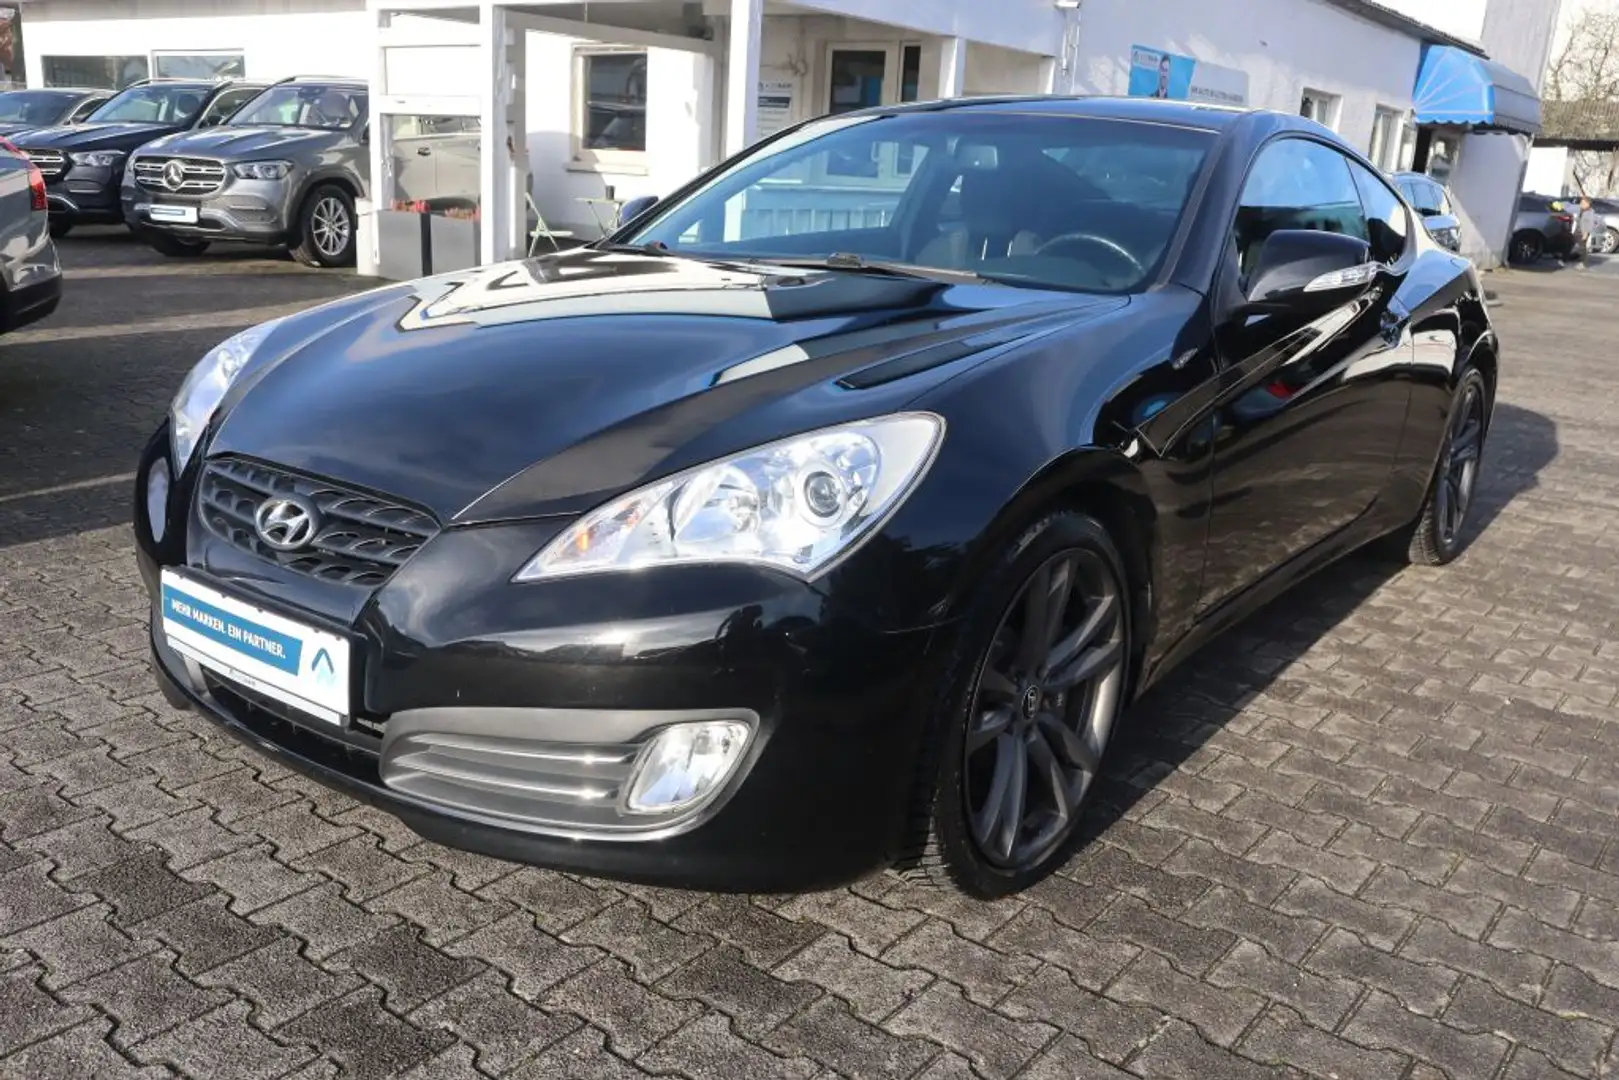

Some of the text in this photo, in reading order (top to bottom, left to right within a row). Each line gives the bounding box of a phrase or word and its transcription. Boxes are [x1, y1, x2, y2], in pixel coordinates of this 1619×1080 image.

[171, 598, 286, 659] MEHR MARKEN. EIN PARTNER.
